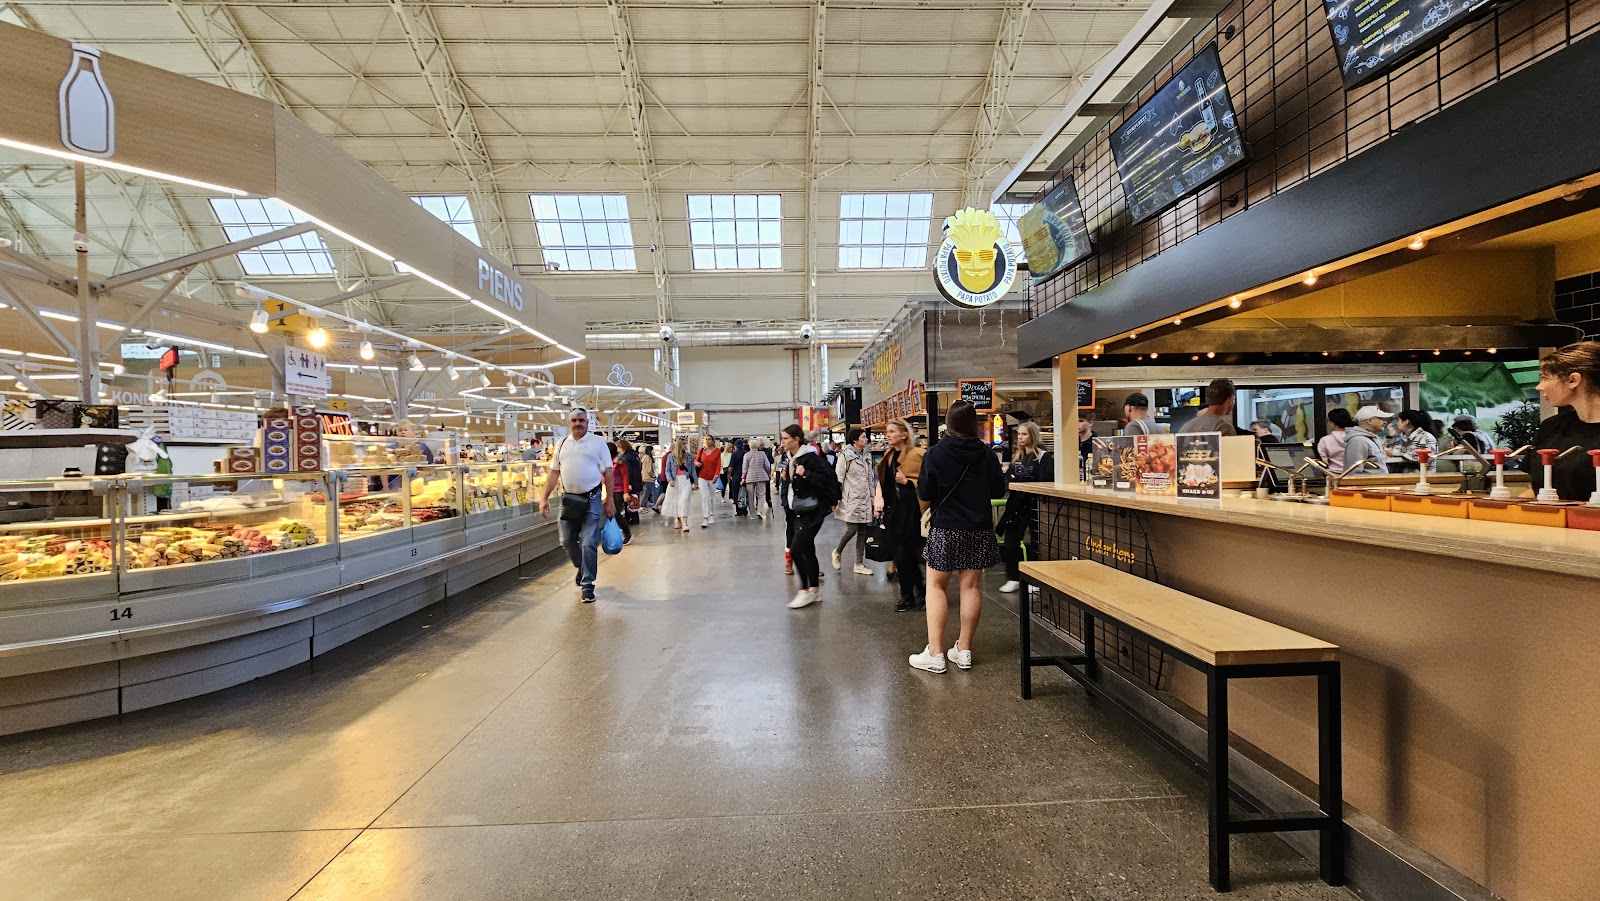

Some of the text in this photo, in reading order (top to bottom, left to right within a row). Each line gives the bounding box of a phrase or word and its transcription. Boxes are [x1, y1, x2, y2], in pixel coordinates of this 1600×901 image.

[939, 242, 952, 284] PAPA POTATO
[1003, 243, 1016, 285] PAPA POTATO
[478, 257, 524, 312] PIENS
[956, 290, 998, 304] PAPA POTATO
[275, 302, 288, 327] 1
[411, 548, 418, 557] 13
[109, 606, 134, 622] 14
